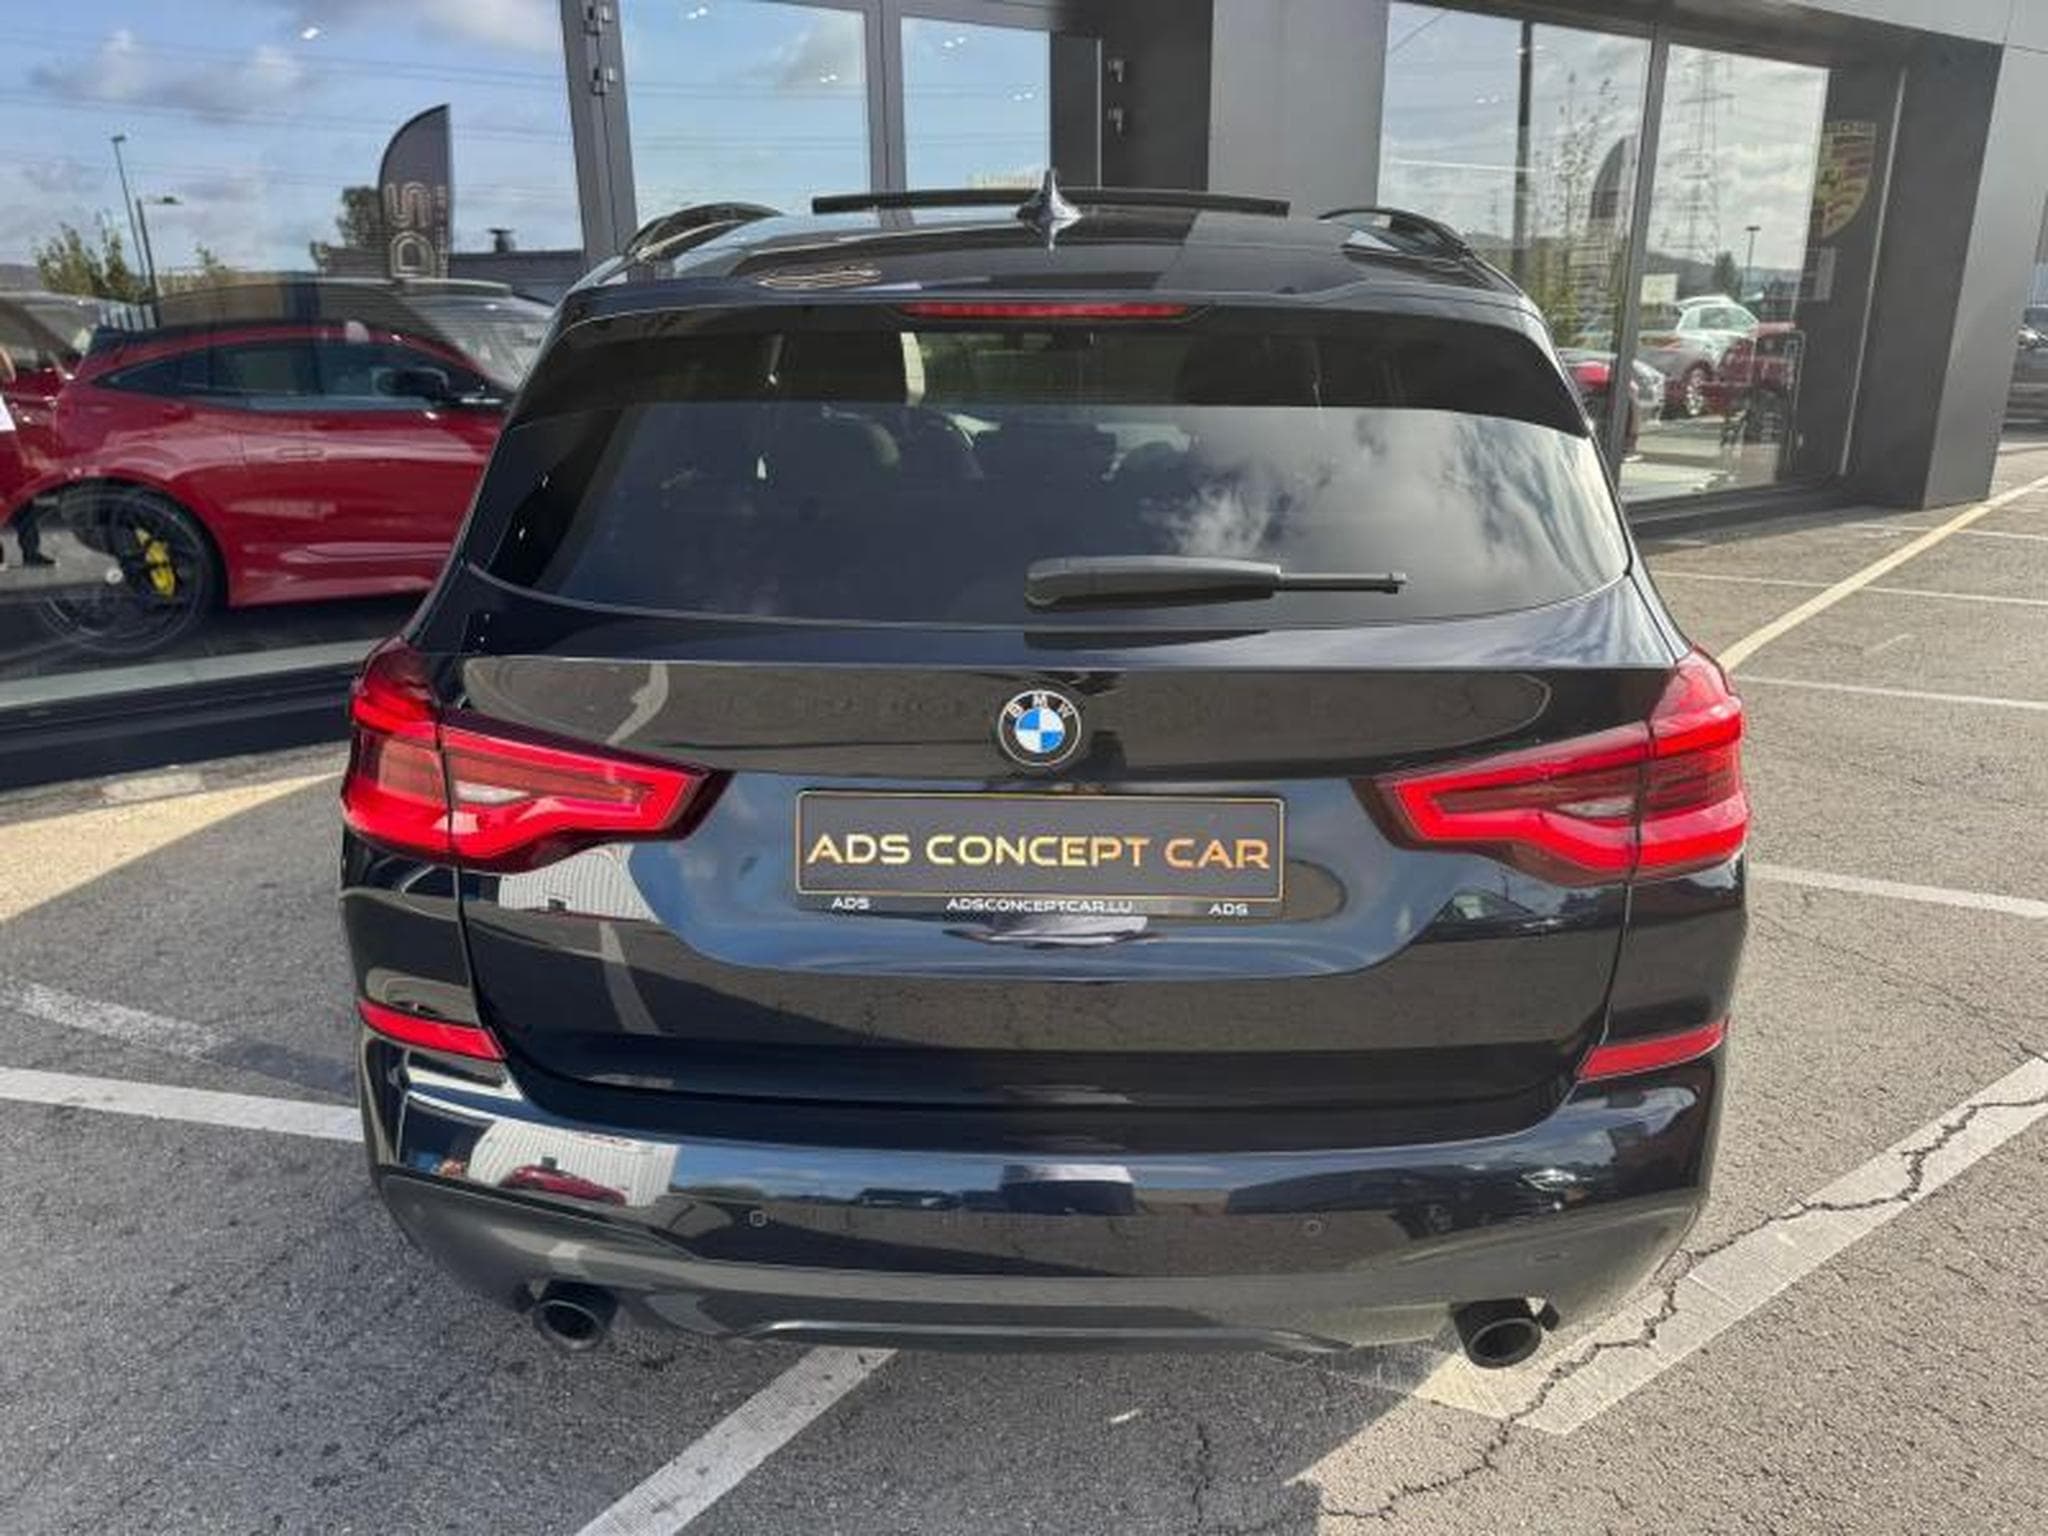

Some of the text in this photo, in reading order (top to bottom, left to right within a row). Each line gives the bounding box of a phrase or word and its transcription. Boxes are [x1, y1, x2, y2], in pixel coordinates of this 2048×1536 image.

[1006, 694, 1075, 719] BMW
[806, 833, 1271, 870] ADS CONCEPT CAR
[832, 897, 871, 910] ADS
[1208, 903, 1249, 916] ADS
